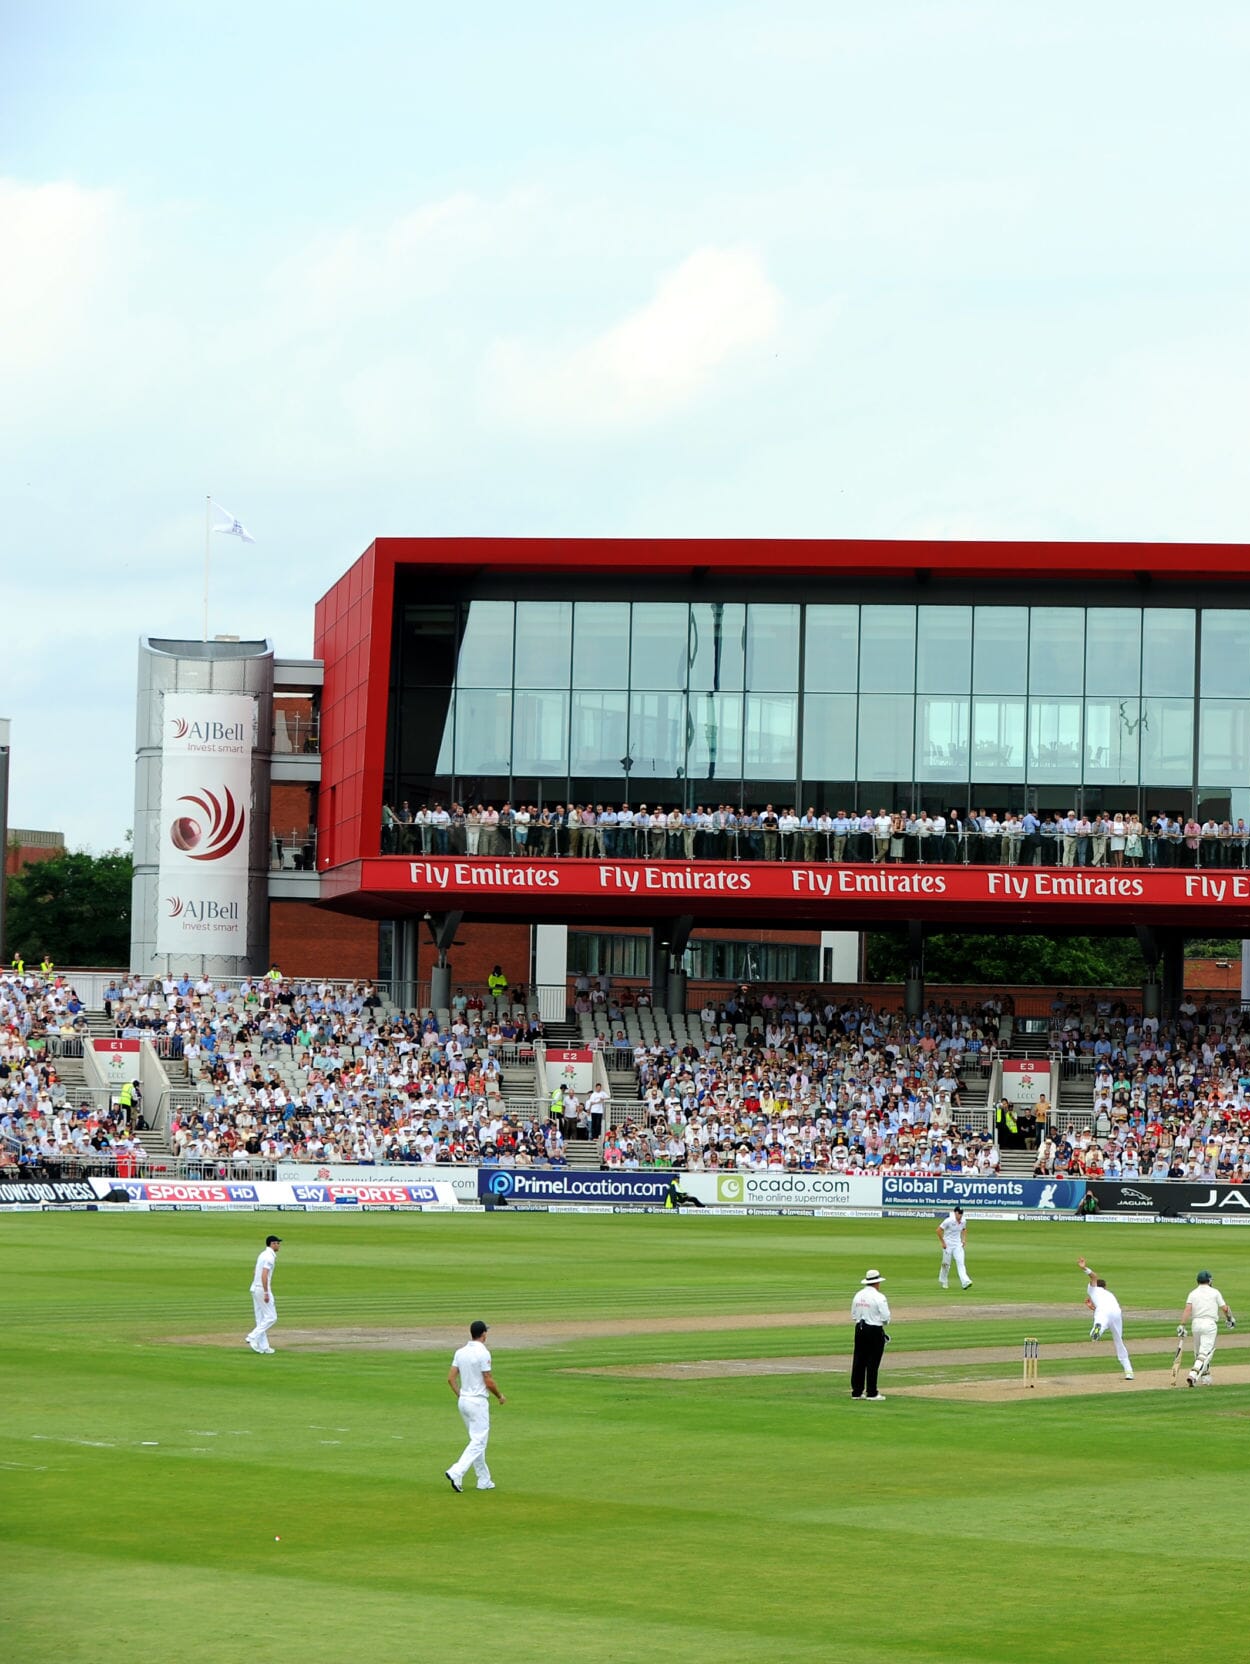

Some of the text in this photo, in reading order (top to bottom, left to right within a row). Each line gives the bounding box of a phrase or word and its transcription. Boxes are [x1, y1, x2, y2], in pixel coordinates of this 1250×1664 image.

[188, 744, 244, 753] Invest smart
[410, 863, 559, 888] Fly Emirates
[600, 866, 750, 891] Fly Emirates
[792, 870, 945, 895] Fly Emirates
[988, 873, 1143, 898] Fly Emirates
[1186, 876, 1226, 901] Fly
[182, 922, 238, 932] Invest smart
[52, 1183, 96, 1200] PRESS
[148, 1185, 226, 1200] SPORTS
[230, 1186, 254, 1199] HD
[514, 1175, 670, 1196] PrimeLocation.com
[747, 1176, 850, 1193] ocado.com
[885, 1179, 1023, 1196] Global Payments
[296, 1186, 434, 1202] sky SPORTS HD
[748, 1193, 850, 1203] The online supermarket
